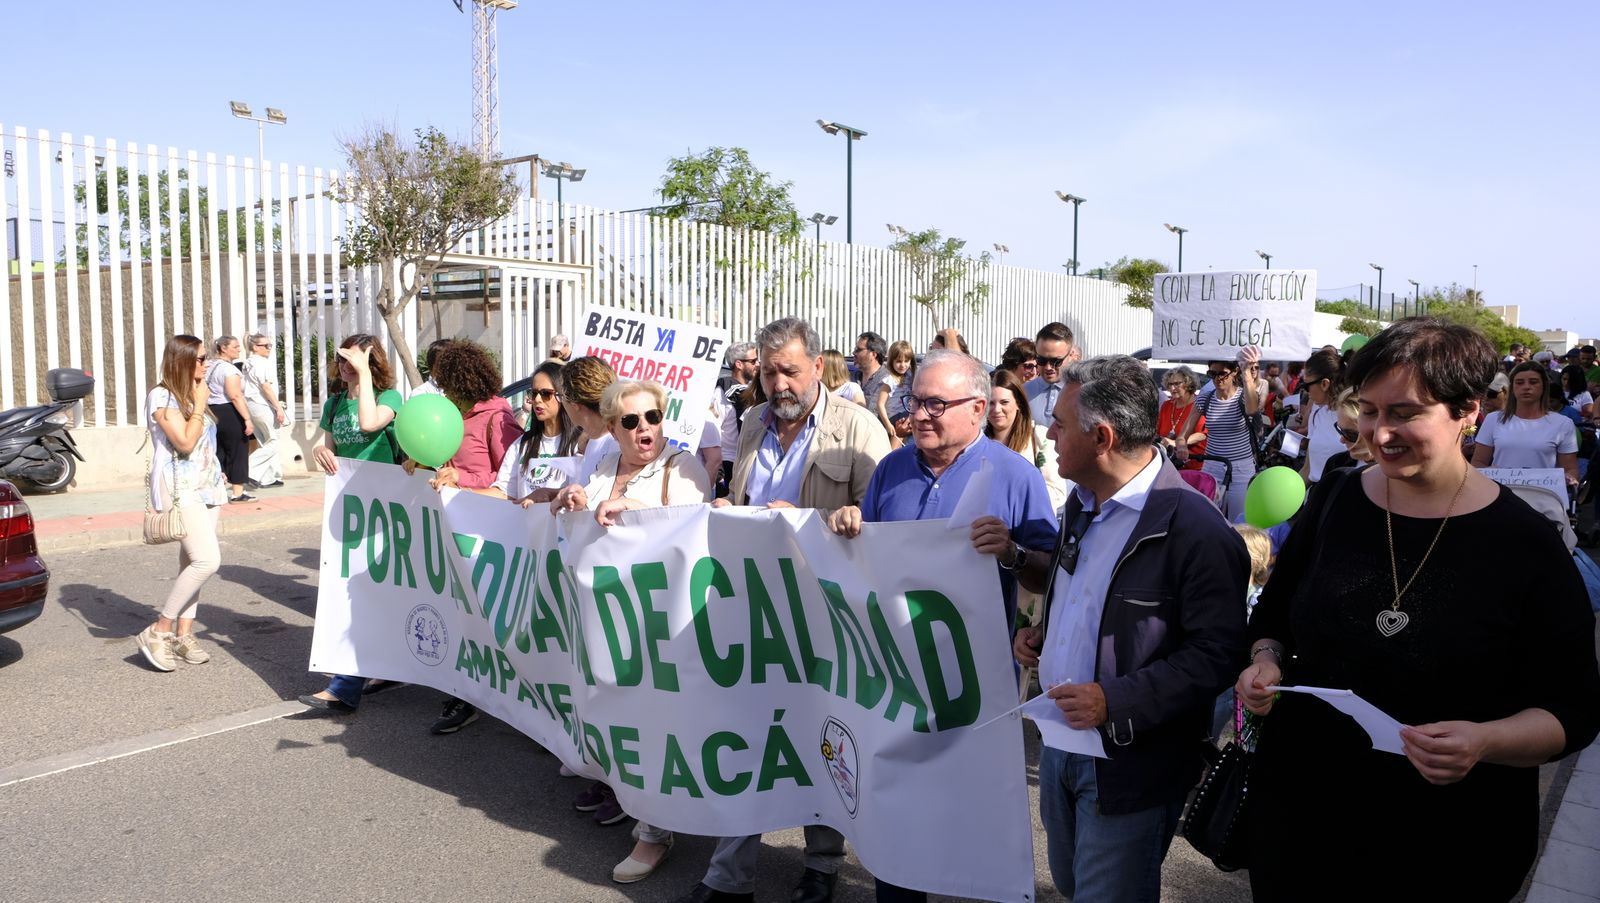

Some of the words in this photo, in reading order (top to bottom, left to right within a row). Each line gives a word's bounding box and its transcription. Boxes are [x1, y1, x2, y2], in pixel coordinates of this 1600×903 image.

[1161, 275, 1190, 304] CON
[1201, 274, 1216, 301] LA
[1229, 271, 1307, 302] EDUCACIÓN
[585, 312, 646, 347] BASTA
[653, 327, 676, 353] YA
[692, 335, 723, 363] DE
[1160, 319, 1180, 348] NO
[1190, 319, 1206, 347] SE
[1217, 318, 1272, 348] JUEGA
[1510, 469, 1524, 477] LA
[340, 494, 418, 589] POR
[592, 561, 681, 693] DE
[689, 556, 981, 734] CALIDAD
[582, 719, 645, 790] DE
[660, 708, 814, 799] ACÁ
